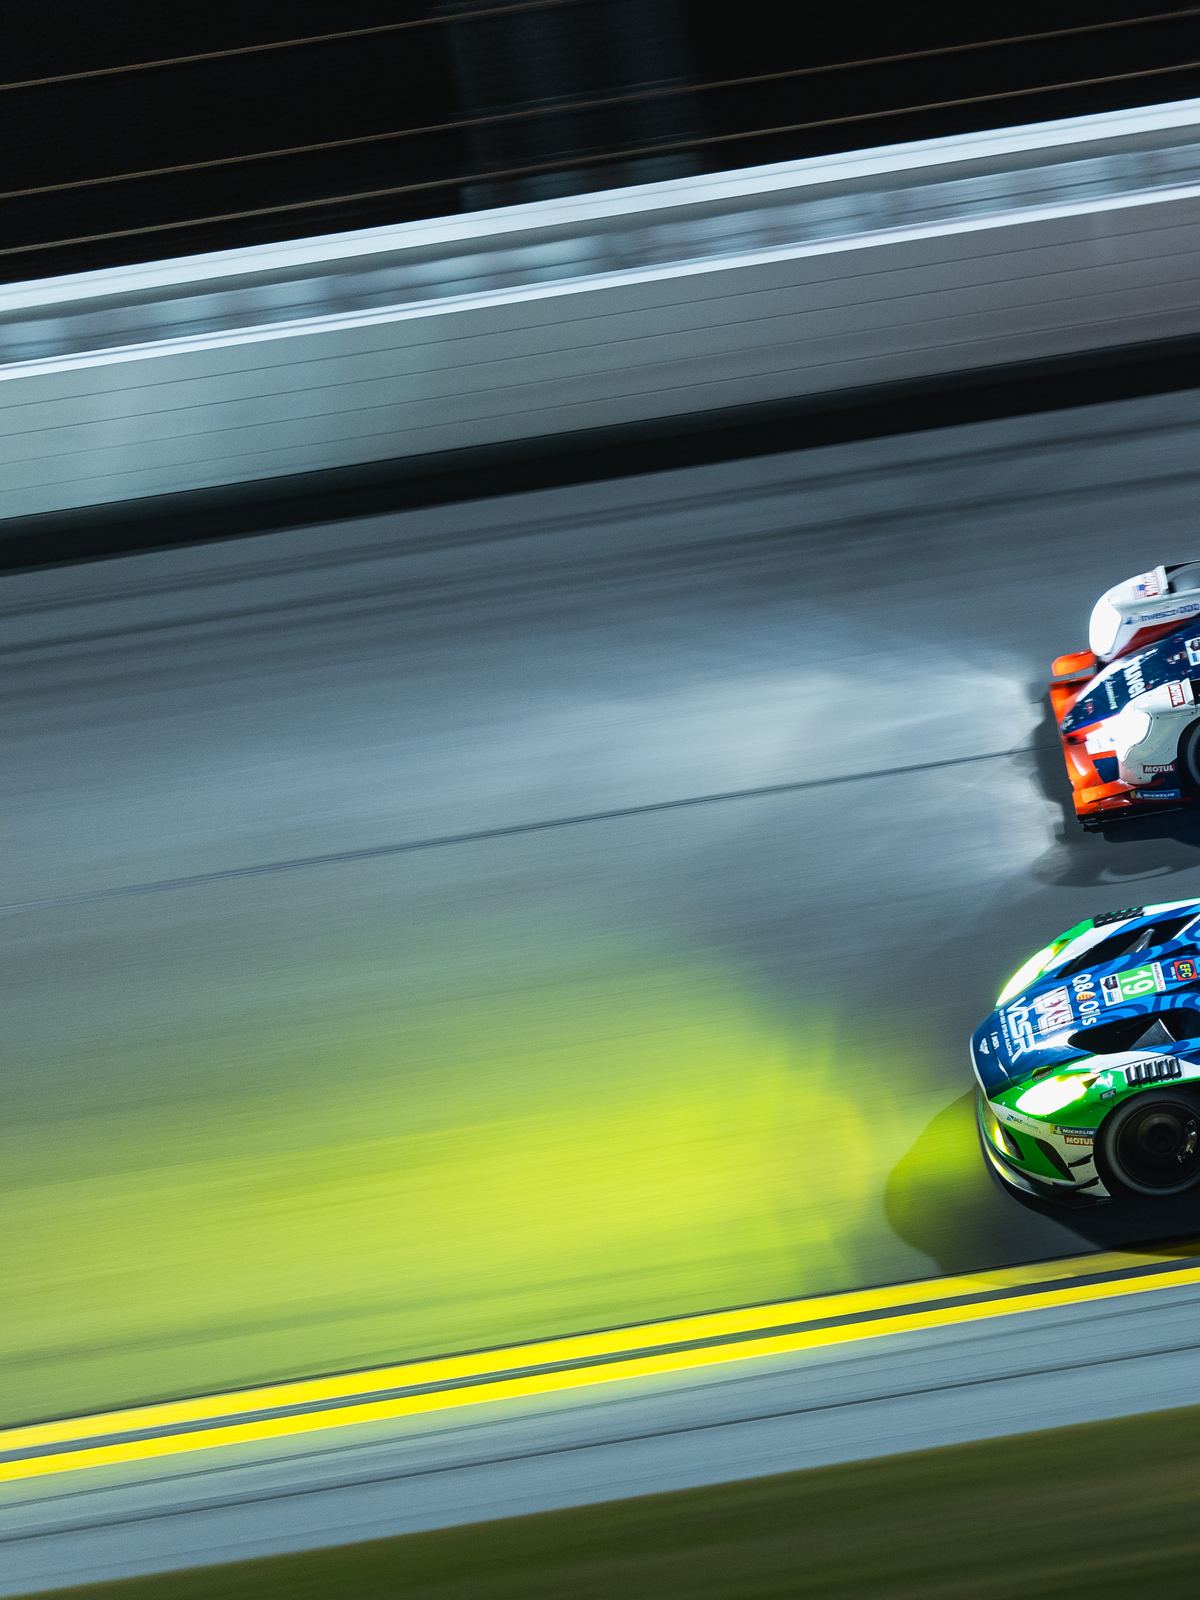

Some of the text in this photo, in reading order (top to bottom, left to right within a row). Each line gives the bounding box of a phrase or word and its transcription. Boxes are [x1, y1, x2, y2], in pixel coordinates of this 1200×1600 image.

[1144, 765, 1174, 773] MOTUL
[1179, 963, 1193, 978] EFC
[1120, 970, 1155, 995] 19
[1072, 973, 1101, 1026] Q8 Oils
[1065, 1136, 1094, 1145] MOTUL
